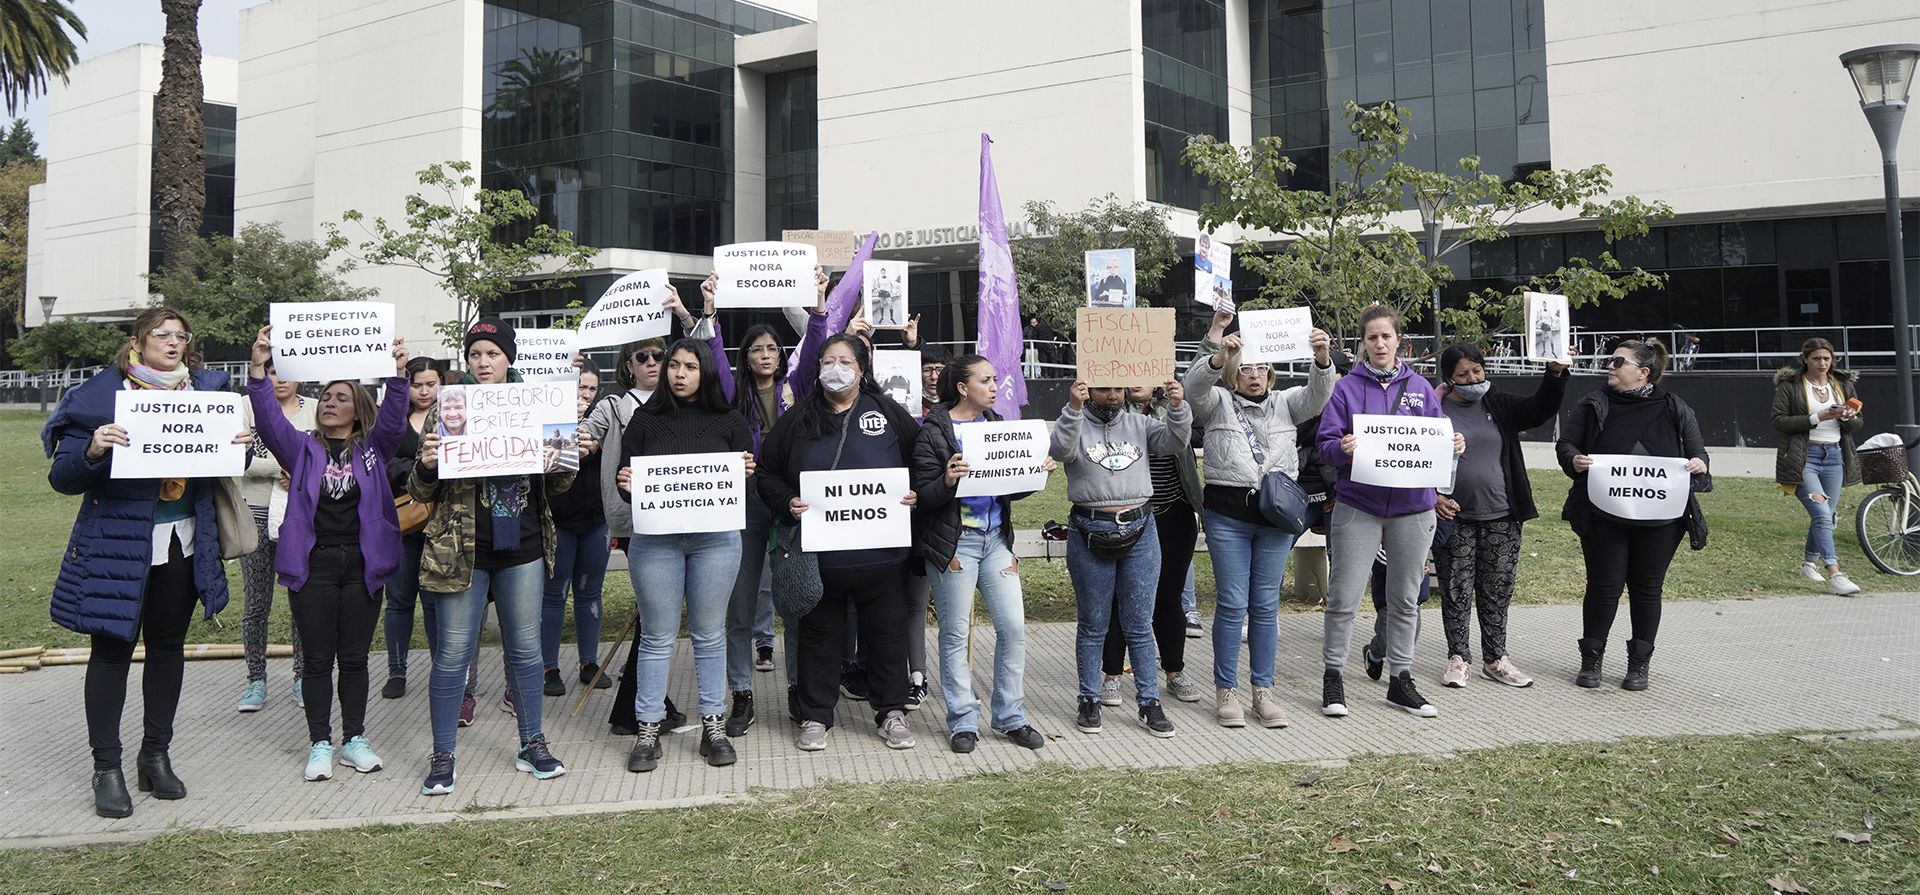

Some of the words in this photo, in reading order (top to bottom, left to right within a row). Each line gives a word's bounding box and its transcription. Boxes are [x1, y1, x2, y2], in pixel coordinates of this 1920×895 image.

[895, 231, 913, 248] DE
[916, 224, 980, 246] JUSTICIA
[737, 280, 795, 288] ESCOBAR!
[600, 298, 650, 311] JUDICIAL
[289, 312, 377, 322] PERSPECTIVA
[585, 315, 644, 330] FEMINISTA
[647, 310, 665, 320] YA!
[1084, 311, 1158, 334] FISCAL
[1249, 319, 1283, 328] JUSTICIA
[1285, 317, 1302, 325] POR
[286, 331, 301, 339] DE
[306, 327, 360, 338] GÉNERO
[365, 327, 380, 335] EN
[1265, 331, 1290, 339] NORA
[516, 338, 566, 346] SPECTIVA
[1082, 336, 1153, 356] CIMINO
[281, 348, 296, 357] LA
[301, 344, 361, 356] JUSTICIA
[366, 343, 386, 351] YA!
[1260, 343, 1296, 353] ESCOBAR
[518, 367, 554, 375] STICIA
[556, 366, 574, 374] YA!
[1084, 359, 1174, 383] RESPONSABLE
[131, 404, 201, 413] JUSTICIA
[207, 405, 234, 414] POR
[162, 424, 203, 433] NORA
[859, 417, 888, 429] UTEP
[1364, 426, 1417, 435] JUSTICIA
[985, 432, 1032, 442] REFORMA
[143, 444, 218, 453] ESCOBAR!
[1388, 443, 1420, 451] NORA
[985, 450, 1032, 460] JUDICIAL
[1375, 460, 1432, 468] ESCOBAR!
[648, 465, 729, 476] PERSPECTIVA
[969, 467, 1024, 478] FEMINISTA
[1611, 467, 1626, 476] NI
[1633, 467, 1667, 478] UNA
[645, 485, 659, 493] DE
[666, 482, 713, 492] GÉNERO
[718, 481, 732, 489] EN
[825, 485, 842, 497] NI
[849, 483, 886, 496] UNA
[1609, 487, 1666, 499] MENOS
[641, 502, 655, 510] LA
[660, 499, 714, 509] JUSTICIA
[719, 497, 737, 505] YA!
[826, 508, 887, 521] MENOS
